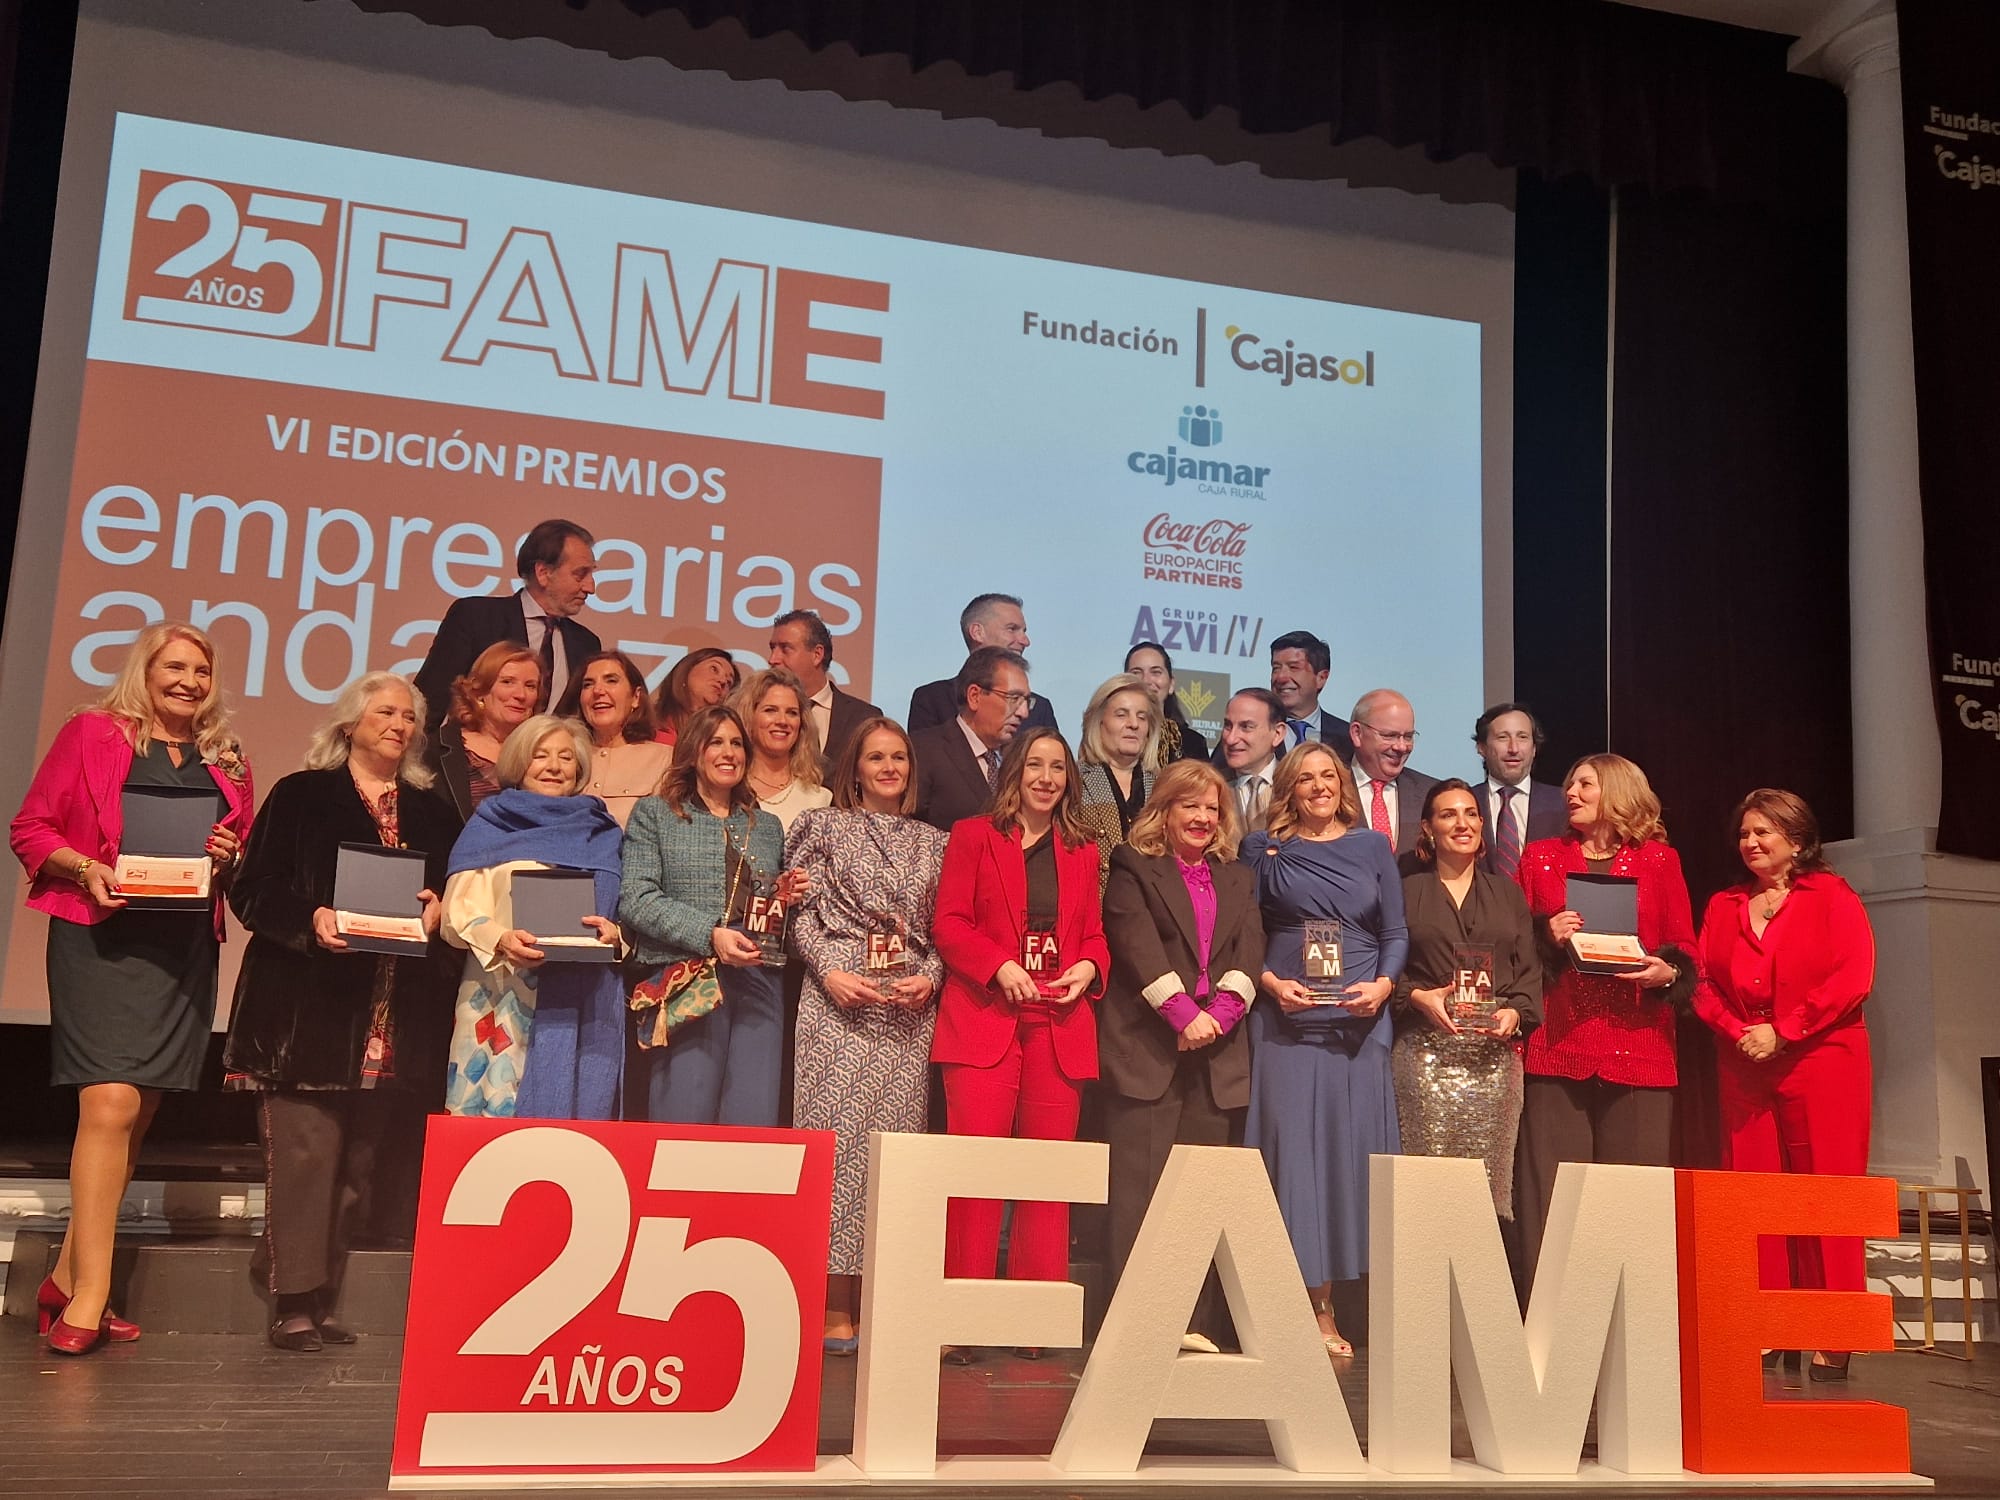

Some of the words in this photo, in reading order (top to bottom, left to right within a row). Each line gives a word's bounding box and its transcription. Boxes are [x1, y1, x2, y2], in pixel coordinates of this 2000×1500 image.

[136, 180, 326, 337] 25
[334, 200, 890, 420] FAME
[184, 277, 265, 309] AÑOS
[1023, 310, 1179, 356] Fundación
[1230, 333, 1375, 386] Cajasol
[266, 414, 311, 454] VI
[328, 424, 506, 477] EDICIÓN
[515, 444, 727, 504] PREMIOS
[1127, 446, 1271, 488] cajamar
[1198, 483, 1227, 497] CAJA
[1230, 487, 1267, 501] RURAL
[1143, 566, 1243, 590] PARTNERS
[1144, 551, 1243, 575] EUROPACIFIC
[1162, 607, 1218, 622] GRUPO
[419, 1126, 807, 1468] 25
[853, 1131, 1911, 1475] FAME
[519, 1344, 685, 1406] AÑOS
